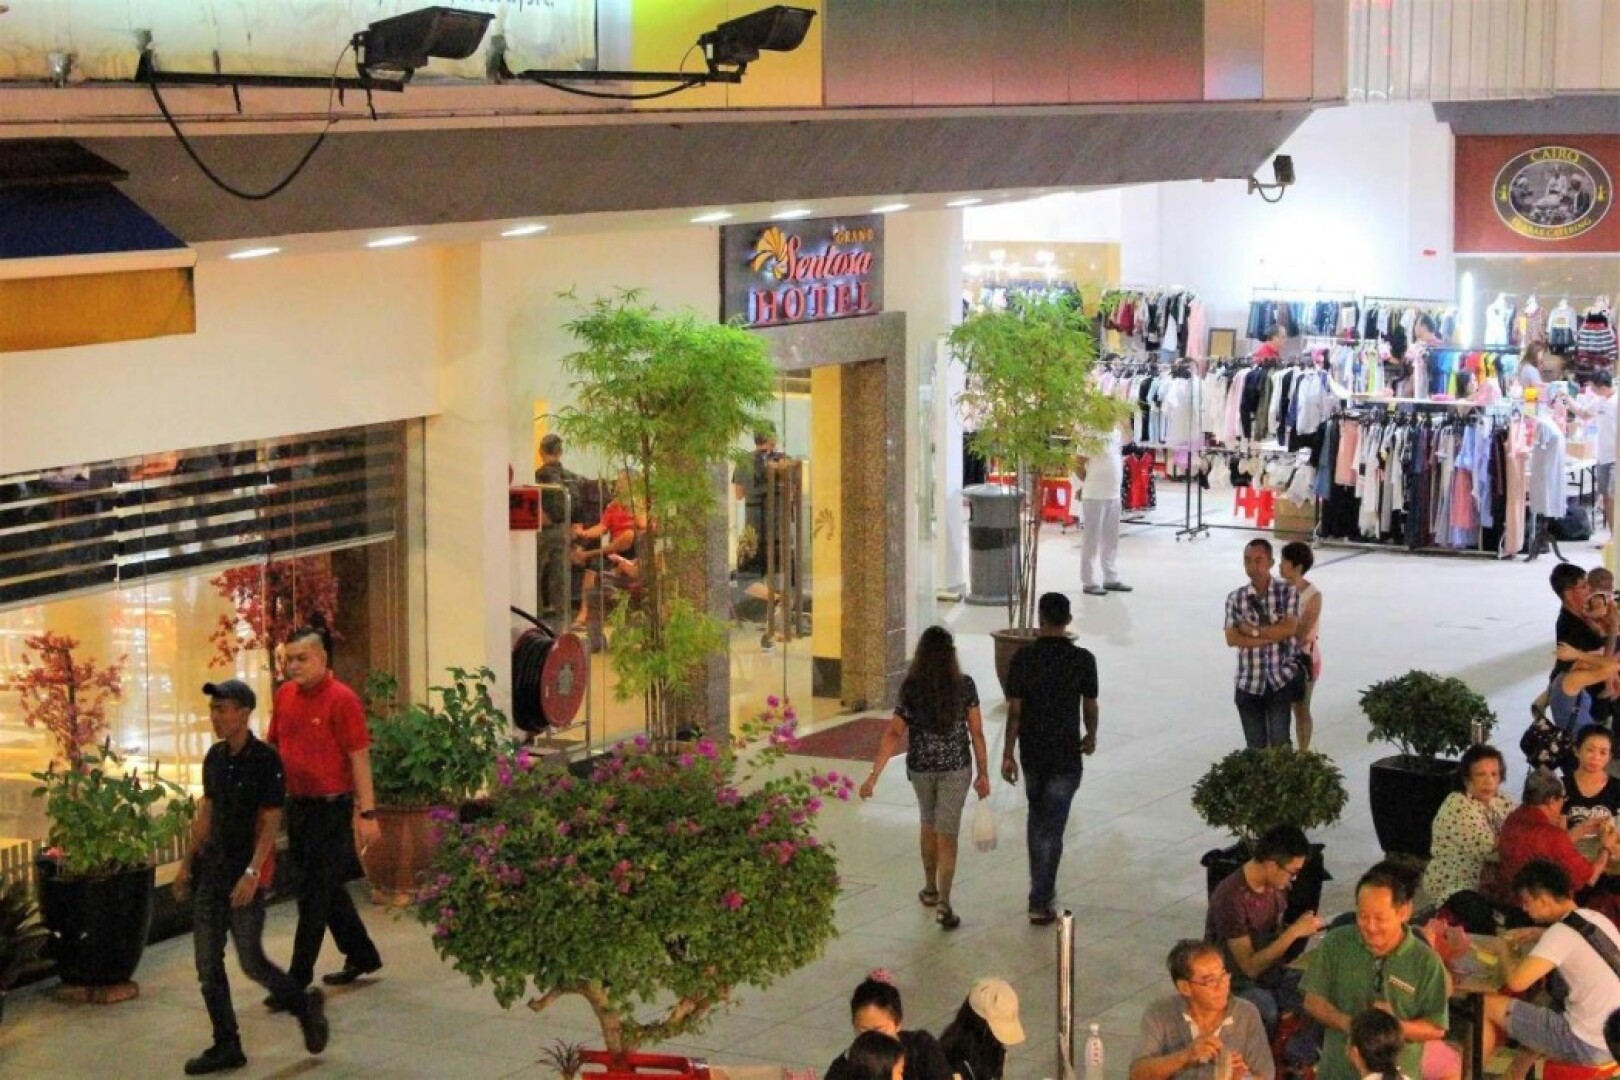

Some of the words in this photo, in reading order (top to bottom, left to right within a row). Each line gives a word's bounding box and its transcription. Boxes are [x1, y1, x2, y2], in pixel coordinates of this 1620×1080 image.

[1530, 148, 1579, 163] CAIRO
[836, 228, 874, 245] GRAND
[785, 235, 872, 282] Sentosa
[754, 281, 873, 325] HOTEL
